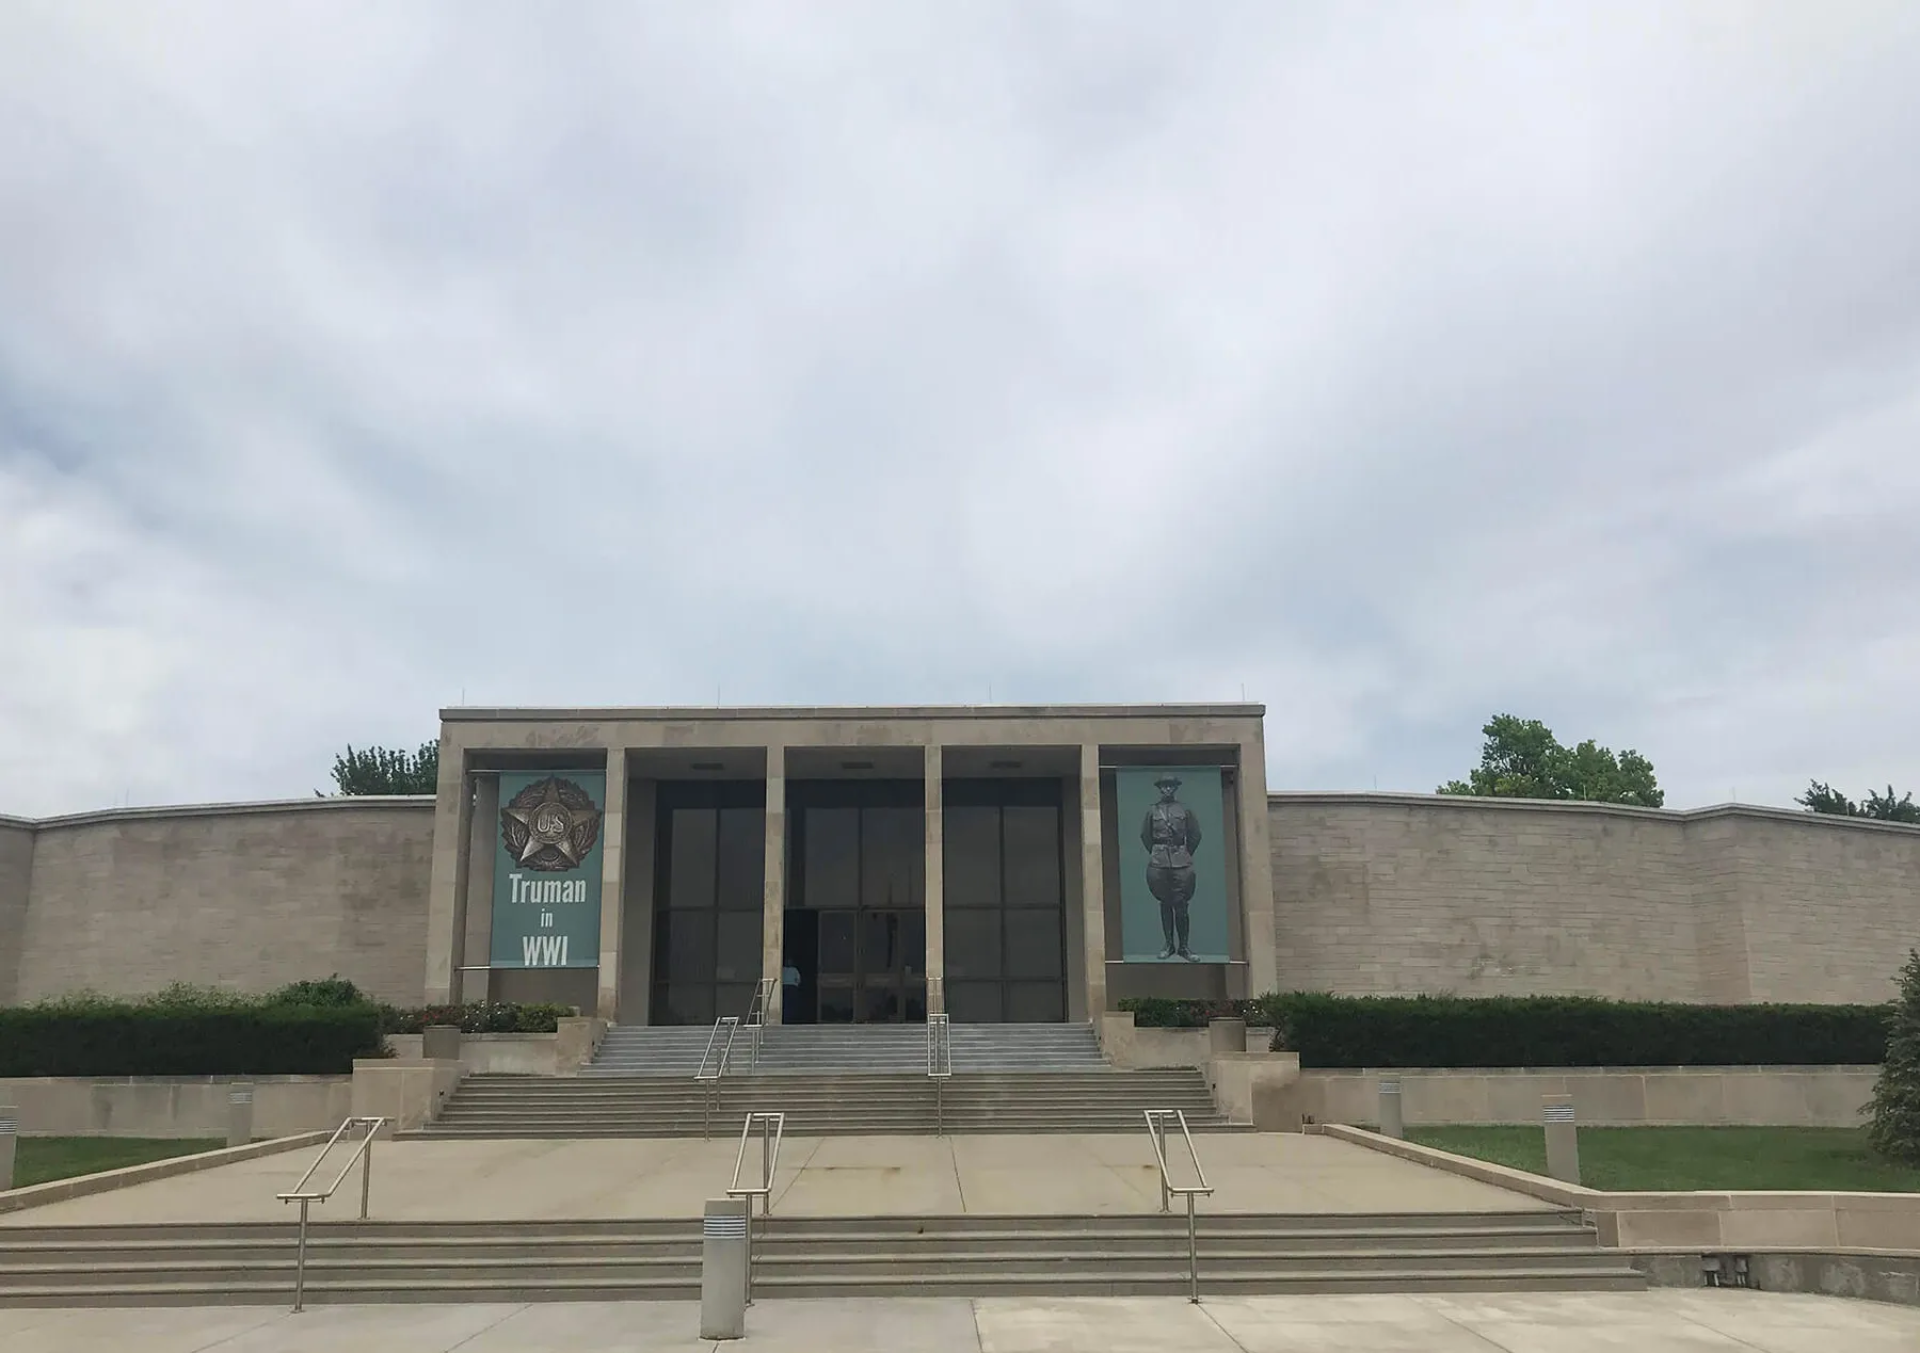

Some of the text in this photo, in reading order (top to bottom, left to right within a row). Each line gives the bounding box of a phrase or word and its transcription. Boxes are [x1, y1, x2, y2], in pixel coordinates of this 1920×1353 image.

[509, 873, 586, 903] Truman
[541, 908, 553, 927] in
[523, 936, 568, 966] WWI
